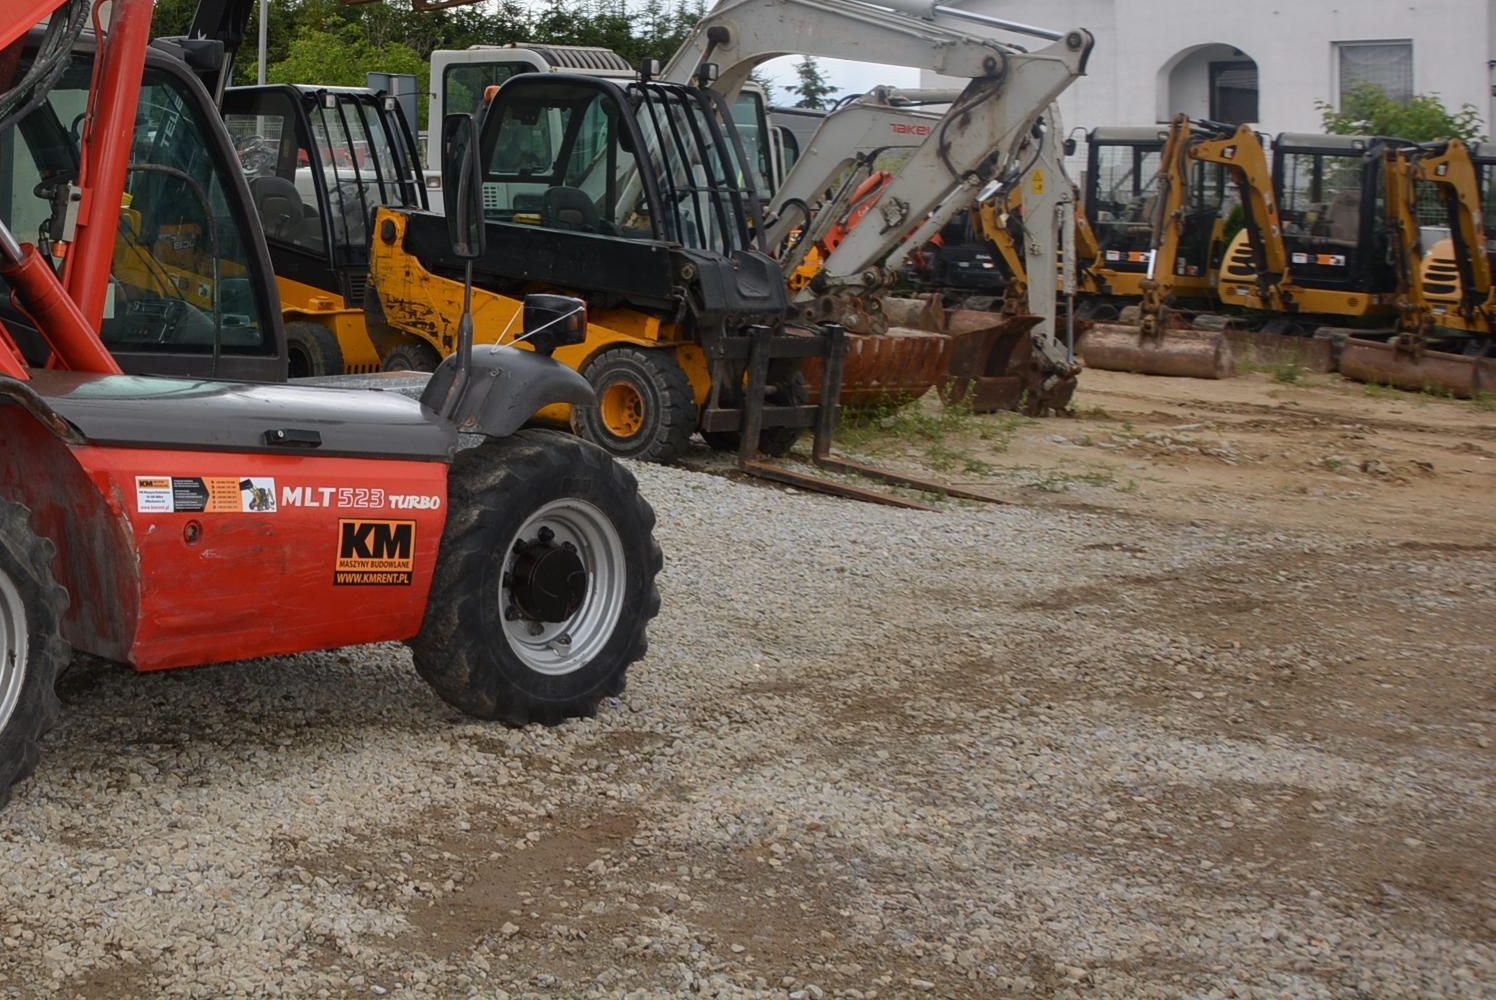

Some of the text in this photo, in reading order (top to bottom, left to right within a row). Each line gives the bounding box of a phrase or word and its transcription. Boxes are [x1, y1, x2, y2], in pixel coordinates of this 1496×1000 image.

[281, 486, 441, 510] MLT 523 TURBO
[340, 522, 412, 559] KM
[339, 560, 410, 569] MASZYNY BUDOWLANE
[336, 573, 409, 584] WWW.KMRENT.PL
